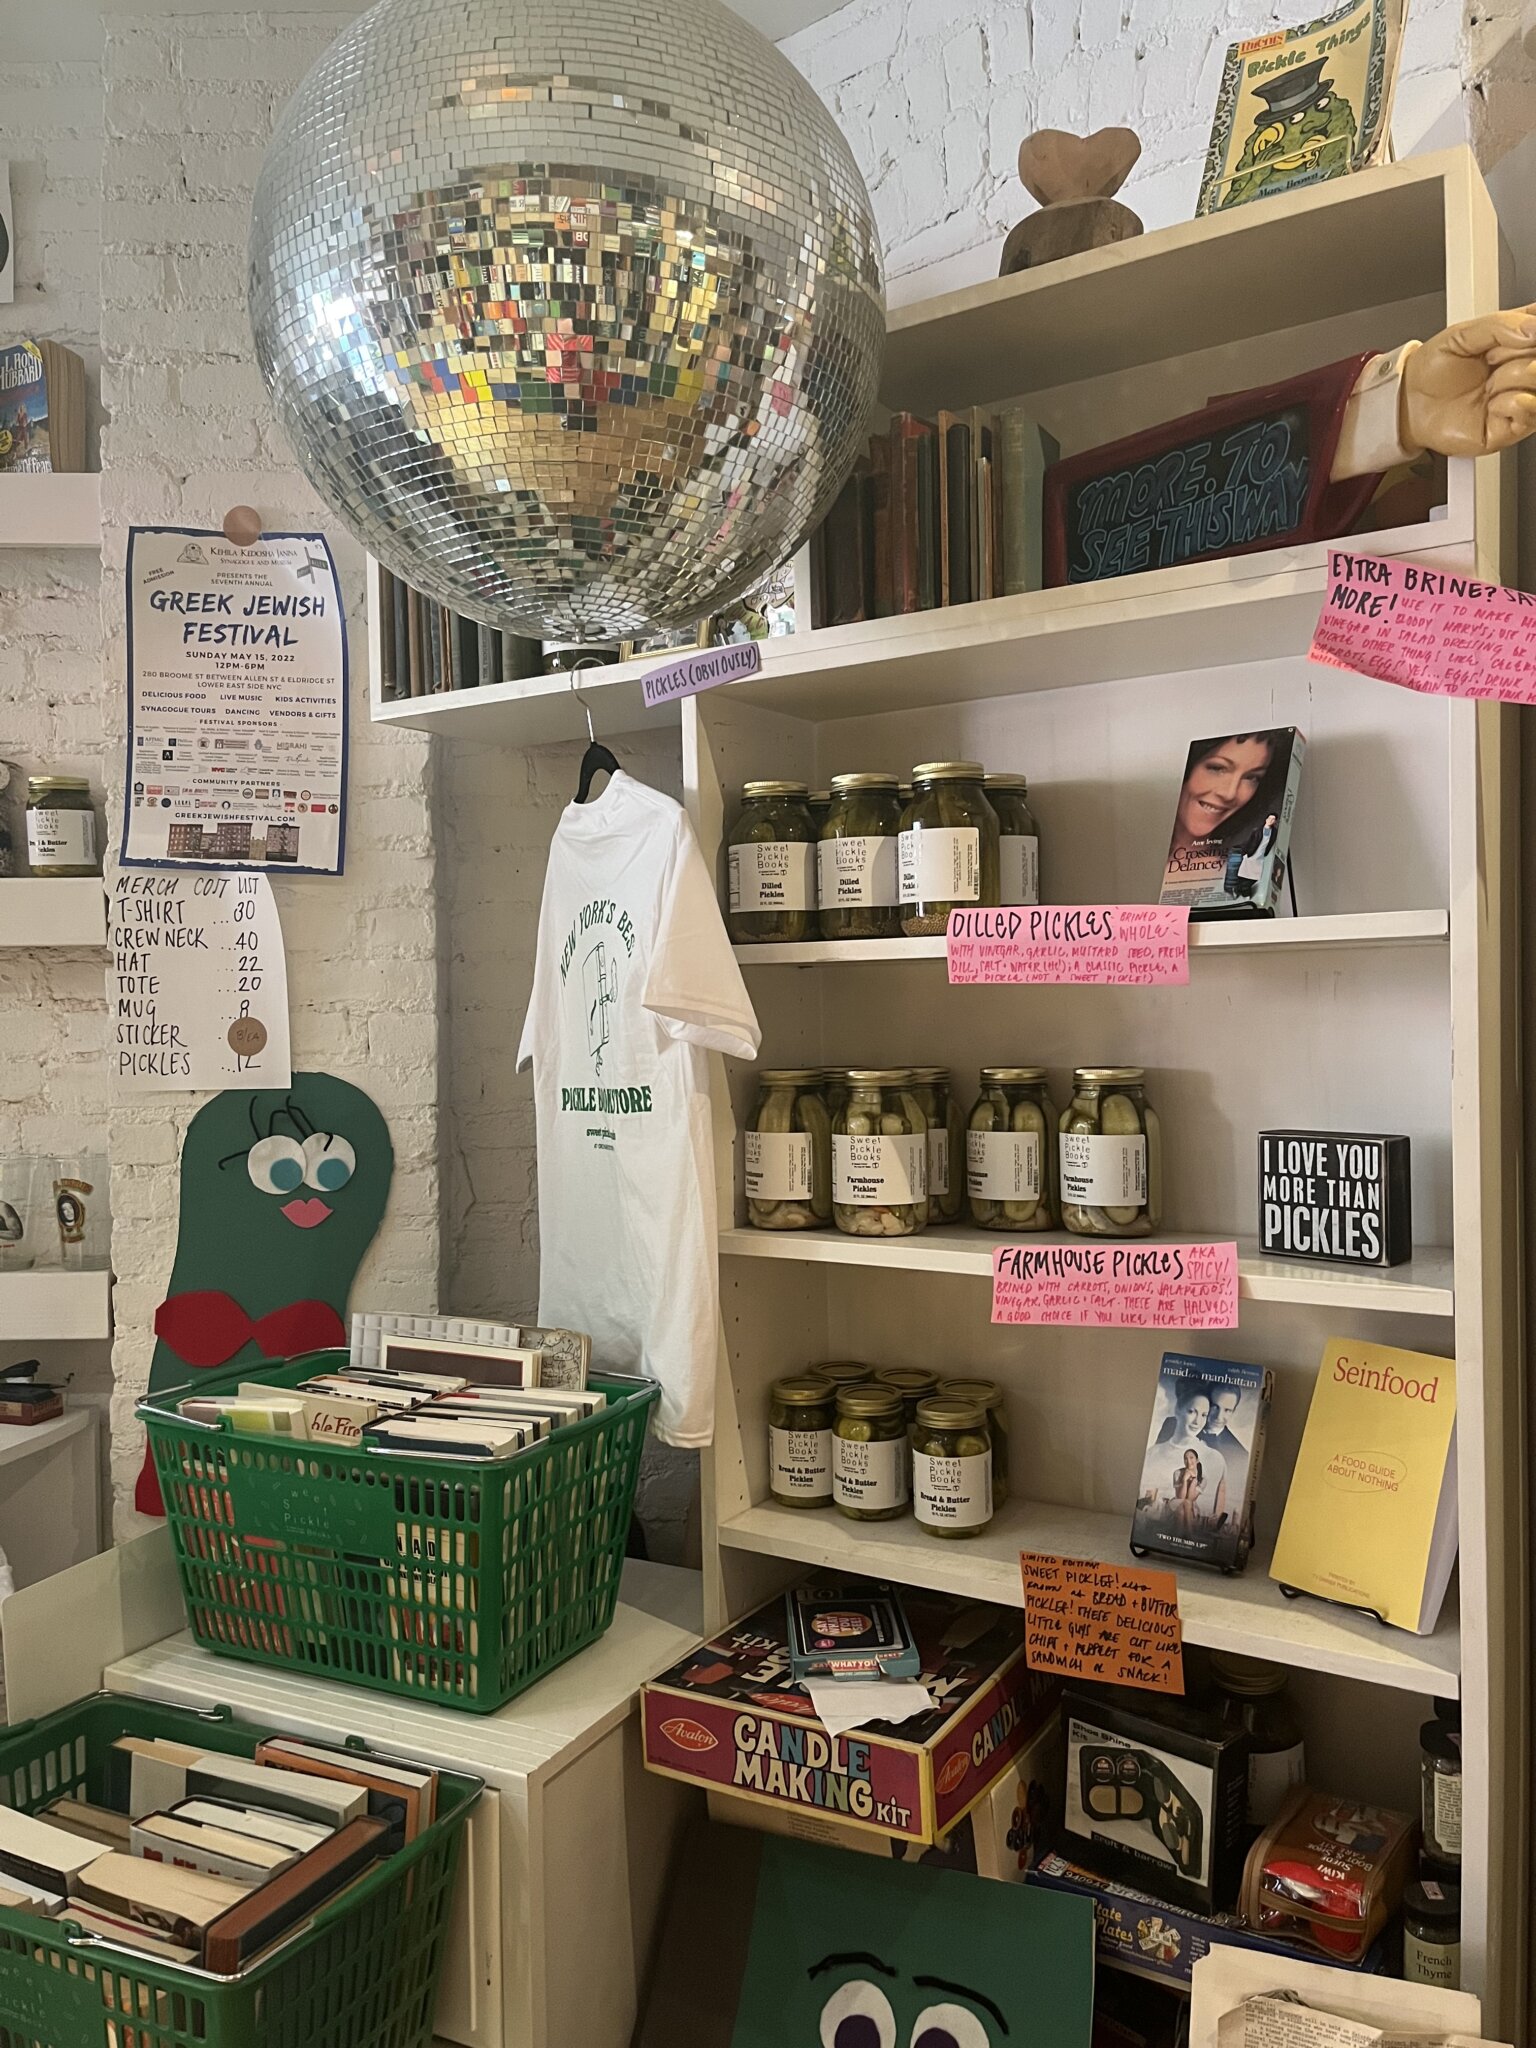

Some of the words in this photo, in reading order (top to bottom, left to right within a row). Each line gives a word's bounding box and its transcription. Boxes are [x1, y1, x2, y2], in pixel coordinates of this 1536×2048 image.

[1248, 50, 1306, 78] Pickle
[1316, 12, 1370, 55] Things
[1222, 421, 1292, 490] TO
[1068, 515, 1155, 584] SEE
[1232, 456, 1310, 543] WAY
[1404, 568, 1496, 602] BRINE?
[150, 590, 234, 615] GREEK
[243, 594, 325, 618] JEWISH
[1330, 584, 1398, 624] MORE!
[183, 622, 298, 648] FESTIVAL
[186, 651, 228, 659] SUNDAY
[255, 654, 268, 662] 15,
[646, 668, 686, 699] PICKLES
[689, 646, 757, 685] (OBVIOUSLY)
[175, 812, 296, 822] GREEKJEWISHFESTIVAL.COM
[757, 852, 789, 861] Pickle
[757, 860, 789, 869] Books
[1174, 848, 1228, 860] Crossing
[1168, 860, 1225, 873] Delancey
[116, 876, 179, 896] MERCH
[194, 876, 230, 898] COST
[759, 890, 785, 898] Pickles
[117, 897, 186, 924] T-SHIRT
[115, 927, 160, 950] CREW
[165, 928, 209, 950] NECK
[236, 931, 258, 951] 40
[560, 920, 576, 987] NEW
[580, 899, 616, 936] YORK'S
[117, 952, 151, 973] HAT
[238, 956, 263, 972] 22
[117, 976, 160, 994] TOTE
[238, 977, 262, 992] 20
[118, 999, 156, 1026] MUG
[117, 1024, 188, 1048] STICKER
[120, 1051, 191, 1076] PICKLES
[562, 1087, 596, 1112] PICKLE
[850, 1136, 881, 1144] Sweet
[851, 1145, 882, 1153] Pickle
[850, 1153, 881, 1161] Books
[1264, 1140, 1270, 1172] I
[1278, 1141, 1328, 1176] LOVE
[1336, 1144, 1378, 1180] YOU
[847, 1176, 884, 1184] Farmhouse
[1264, 1175, 1316, 1204] MORE
[1327, 1179, 1379, 1210] THAN
[1265, 1203, 1379, 1259] PICKLES
[998, 1248, 1106, 1280] FARMHOUSE
[1189, 1246, 1216, 1258] AKA
[1187, 1258, 1229, 1281] SPICY!
[1038, 1282, 1060, 1291] WITH
[1163, 1367, 1189, 1377] maid
[1201, 1373, 1257, 1388] manhattan
[1333, 1356, 1439, 1403] Seinfood
[930, 1458, 961, 1467] Sweet
[930, 1467, 962, 1476] Pickle
[1334, 1454, 1339, 1462] A
[1342, 1456, 1366, 1470] FOOD
[1368, 1464, 1396, 1479] GUIDE
[930, 1475, 961, 1484] Books
[1328, 1464, 1356, 1479] ABOUT
[1358, 1473, 1398, 1492] NOTHING
[931, 1504, 956, 1513] Pickles
[946, 1495, 970, 1503] Butter
[1024, 1565, 1060, 1580] SWEET
[1117, 1614, 1177, 1637] DELICIOUS
[1130, 1636, 1152, 1650] CUT
[1117, 1666, 1168, 1684] SNACK!
[664, 1721, 715, 1746] Avalon
[733, 1714, 871, 1781] CANDLE
[732, 1749, 873, 1818] MAKING
[1317, 1864, 1345, 1880] KIWI
[1417, 1950, 1452, 1966] French
[1416, 1962, 1452, 1979] Thyme
